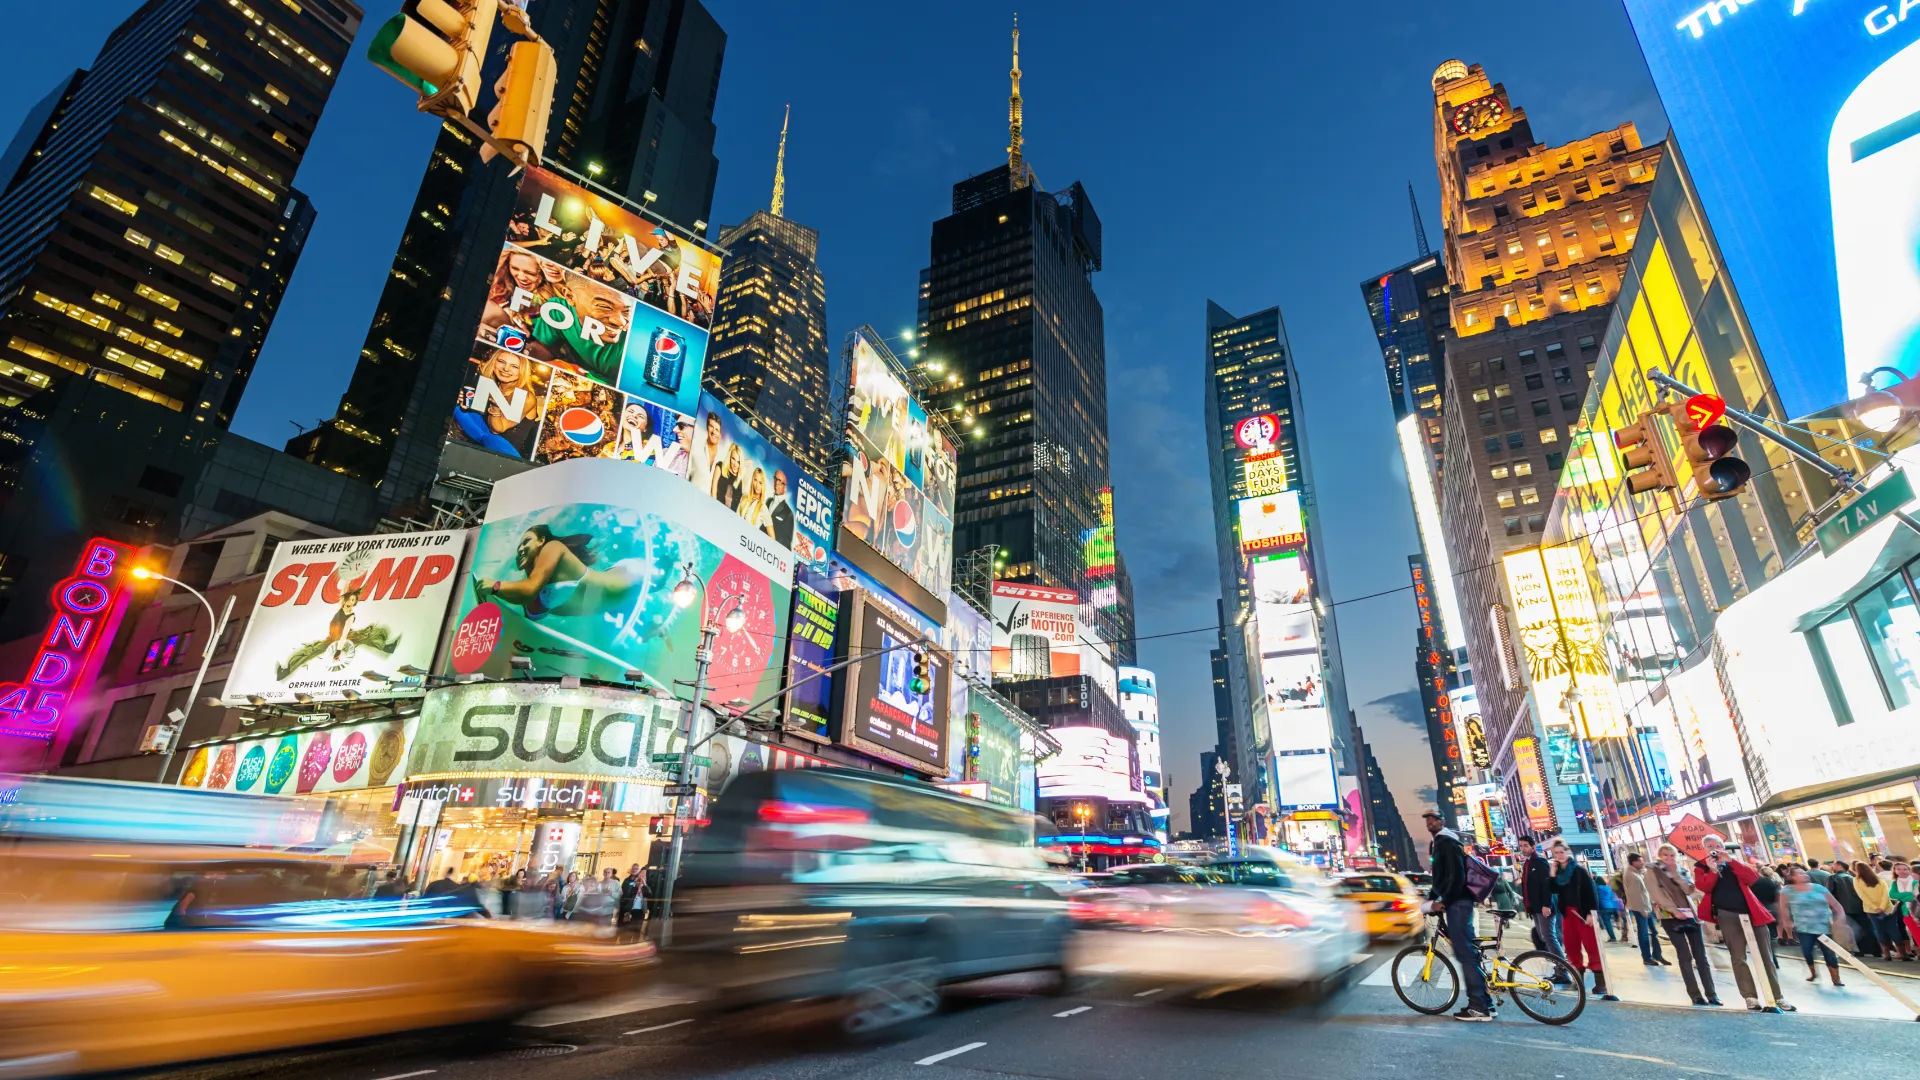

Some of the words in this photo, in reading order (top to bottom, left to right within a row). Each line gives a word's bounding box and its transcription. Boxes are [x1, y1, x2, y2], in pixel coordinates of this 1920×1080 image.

[1676, 0, 1751, 38] Th
[534, 193, 702, 299] LIVE
[510, 287, 606, 347] FOR
[651, 354, 660, 378] pepsi
[1245, 451, 1282, 463] TOSHIBA
[1252, 460, 1278, 470] FALL
[922, 449, 955, 495] FOR
[1253, 476, 1280, 488] FUN
[799, 479, 816, 496] CATCH
[816, 491, 833, 507] EVERY
[796, 487, 832, 531] EPIC
[1838, 516, 1850, 535] 7
[1855, 499, 1879, 527] Av
[795, 510, 830, 541] MOMENT
[291, 544, 327, 555] WHERE
[328, 541, 355, 553] NEW
[354, 539, 385, 551] YORK
[385, 536, 420, 549] TURNS
[422, 535, 434, 546] IT
[436, 535, 451, 546] UP
[1244, 532, 1304, 551] TOSHIBA
[740, 534, 780, 569] swatch
[1516, 573, 1534, 582] THE
[996, 586, 1077, 601] NITTO
[1515, 583, 1542, 596] LION
[1516, 596, 1548, 611] KING
[32, 545, 116, 686] BOND
[1031, 610, 1074, 622] EXPERIENCE
[459, 617, 500, 639] PUSH
[1031, 618, 1075, 634] MOTIVO
[458, 637, 469, 646] THE
[470, 633, 495, 644] BUTTON
[1052, 632, 1075, 642] .com
[454, 644, 470, 658] OF
[471, 640, 494, 655] FUN
[1413, 568, 1433, 639] ERNST
[1429, 652, 1440, 665] &
[1435, 679, 1459, 759] YOUNG
[288, 680, 326, 690] ORPHEUM
[329, 678, 362, 688] THEATRE
[1080, 675, 1088, 709] 1500
[0, 688, 64, 725] 45
[870, 697, 912, 728] PARANORMAL
[339, 744, 365, 757] PUSH
[242, 756, 264, 769] PUSH
[335, 762, 345, 771] OF
[346, 761, 360, 770] FUN
[238, 773, 248, 782] OF
[247, 771, 260, 781] FUN
[680, 786, 692, 794] WAY
[1685, 843, 1703, 851] AHE
